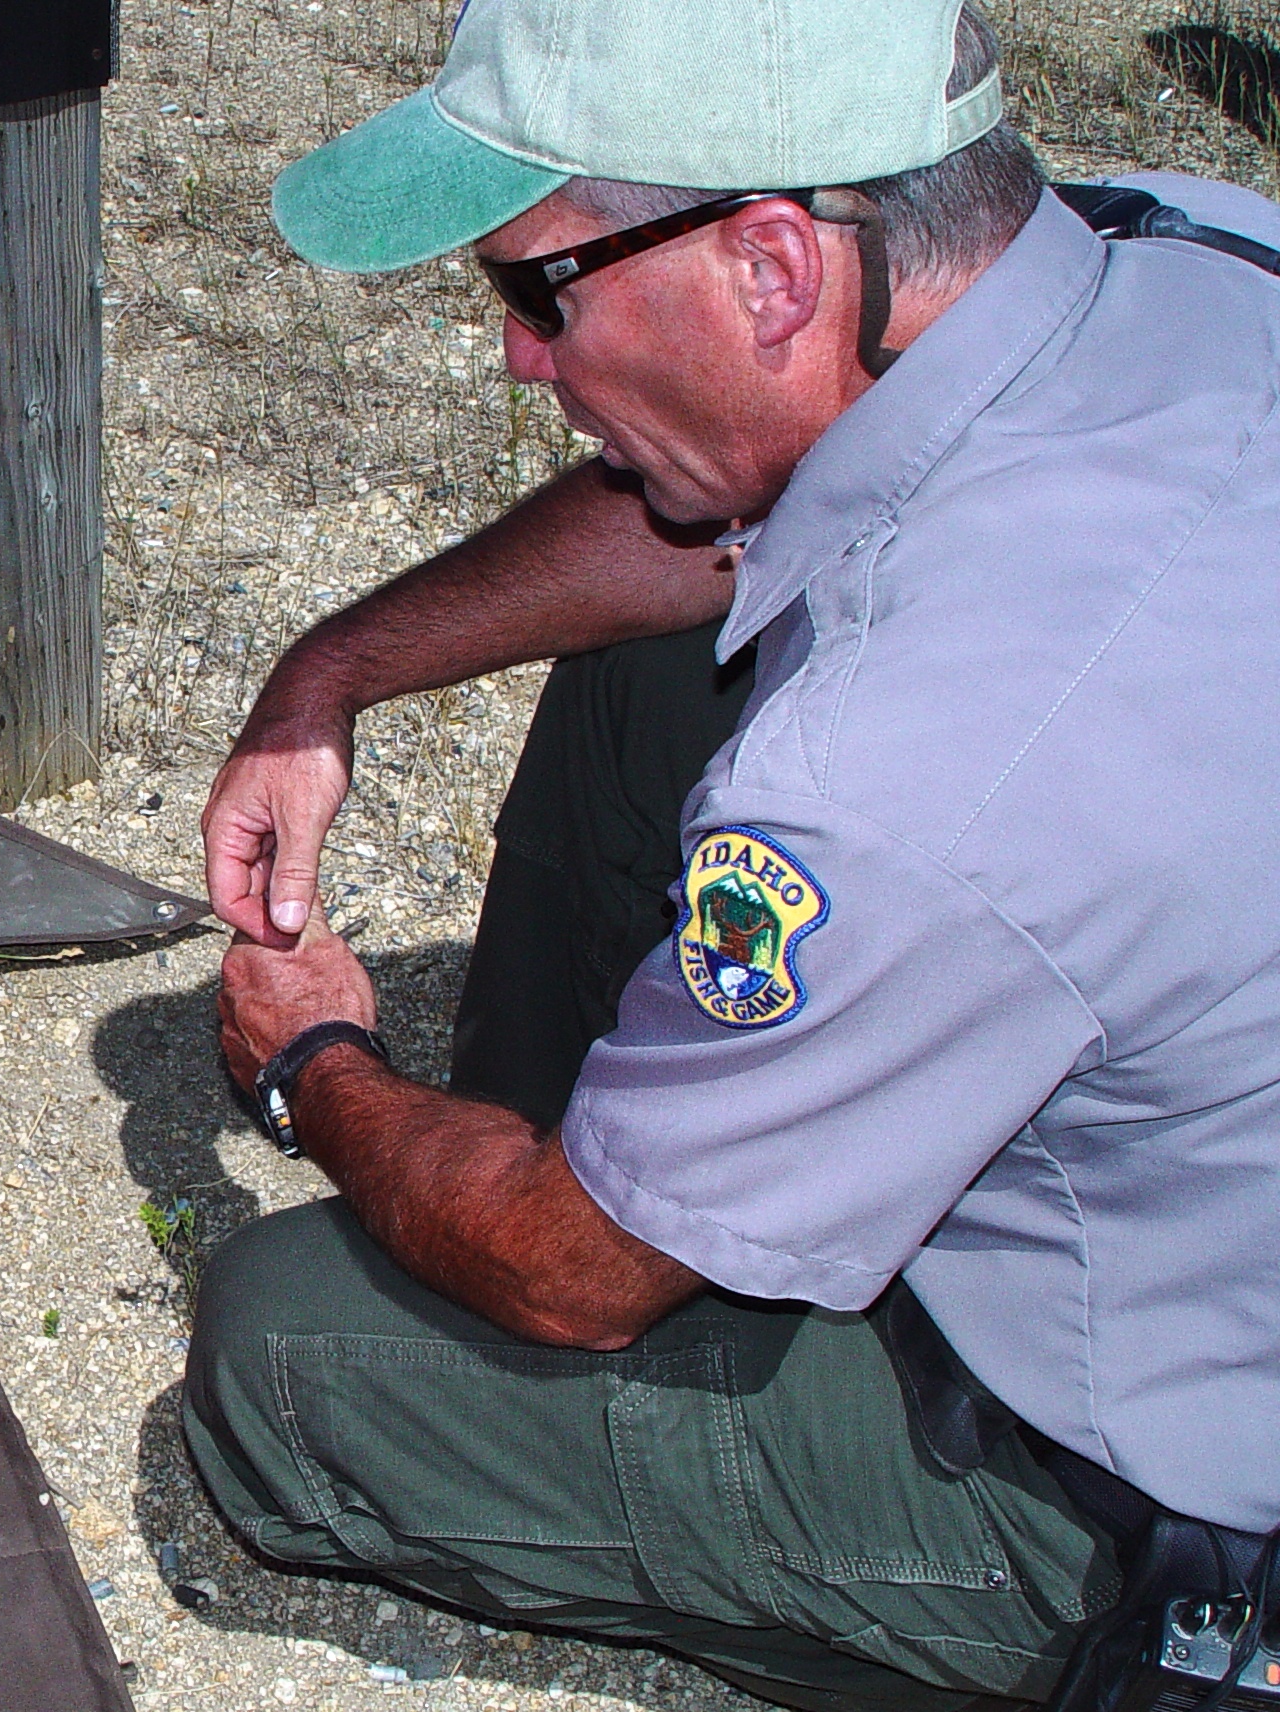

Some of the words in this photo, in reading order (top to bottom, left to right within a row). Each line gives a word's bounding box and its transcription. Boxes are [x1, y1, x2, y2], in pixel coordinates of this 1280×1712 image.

[698, 841, 805, 906] IDAHO
[683, 938, 718, 1003] FISH
[710, 1000, 730, 1018] &
[731, 978, 791, 1021] GAME
